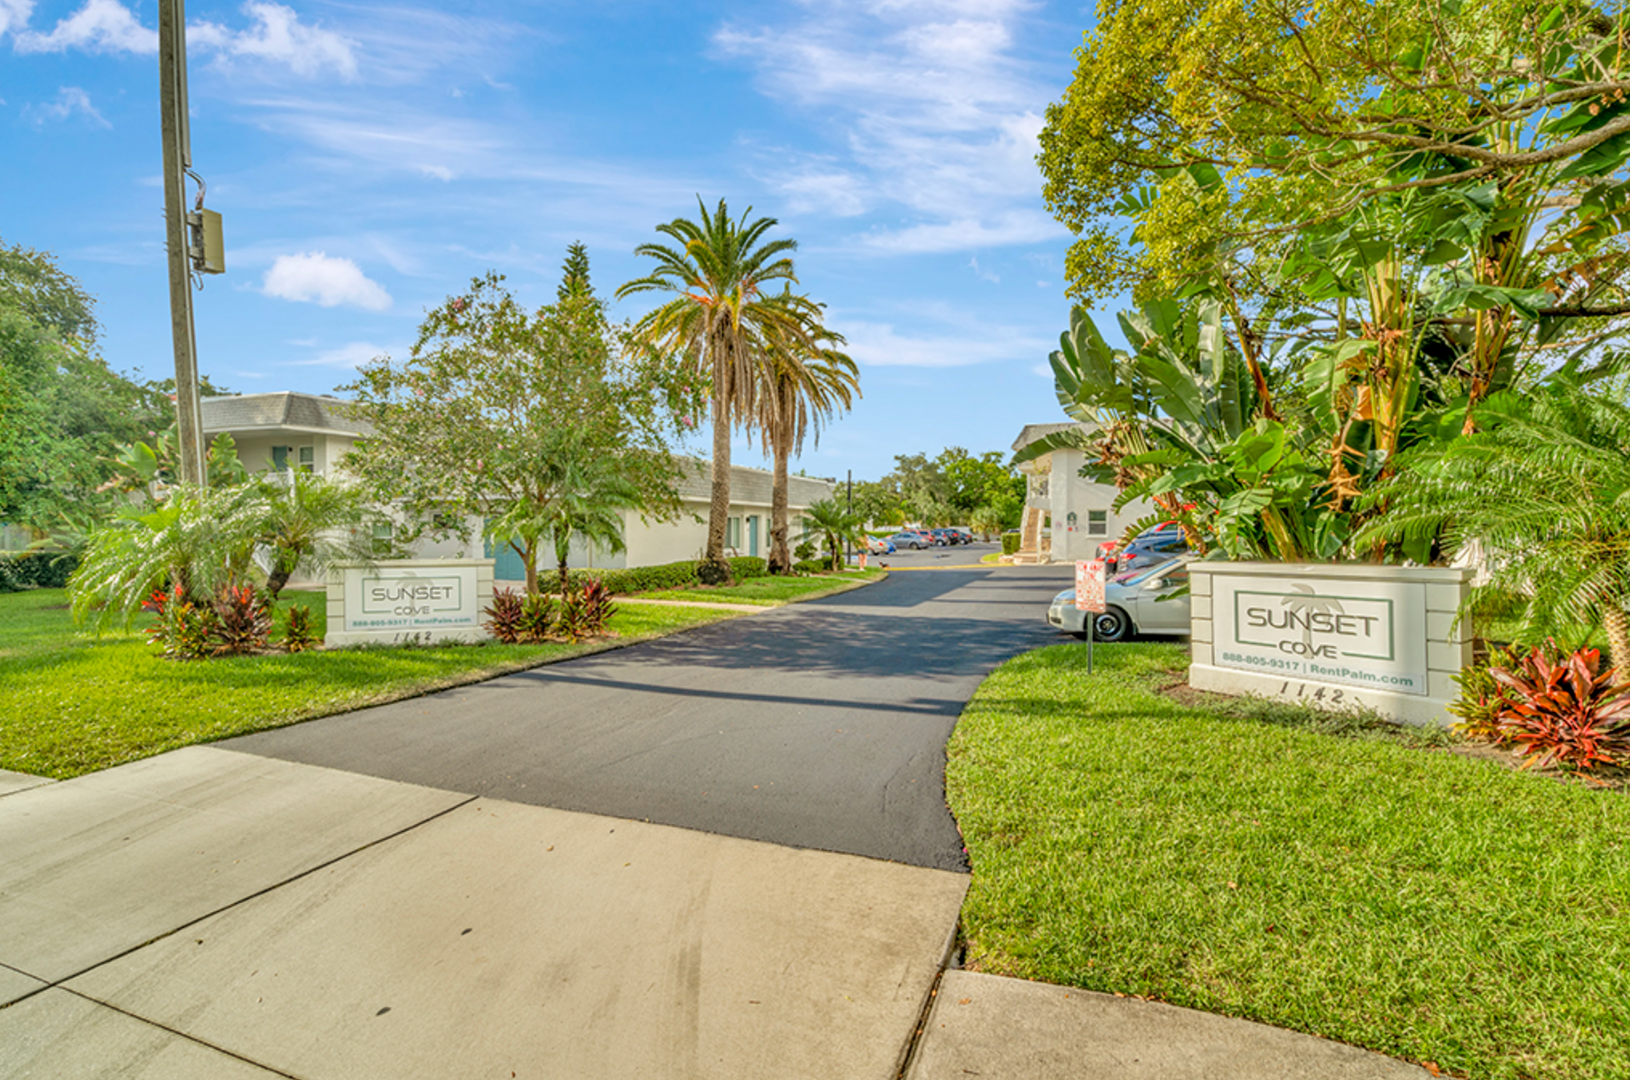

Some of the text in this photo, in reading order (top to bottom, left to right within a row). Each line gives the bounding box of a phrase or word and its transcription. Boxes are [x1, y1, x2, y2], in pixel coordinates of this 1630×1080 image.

[371, 586, 453, 602] SUNSET
[393, 606, 430, 616] COVE
[1246, 607, 1379, 637] SUNSET
[1278, 640, 1337, 659] COVE
[1222, 651, 1299, 671] 888-805-9317
[1310, 663, 1414, 687] RentPalm.com
[1280, 681, 1344, 703] 1142
